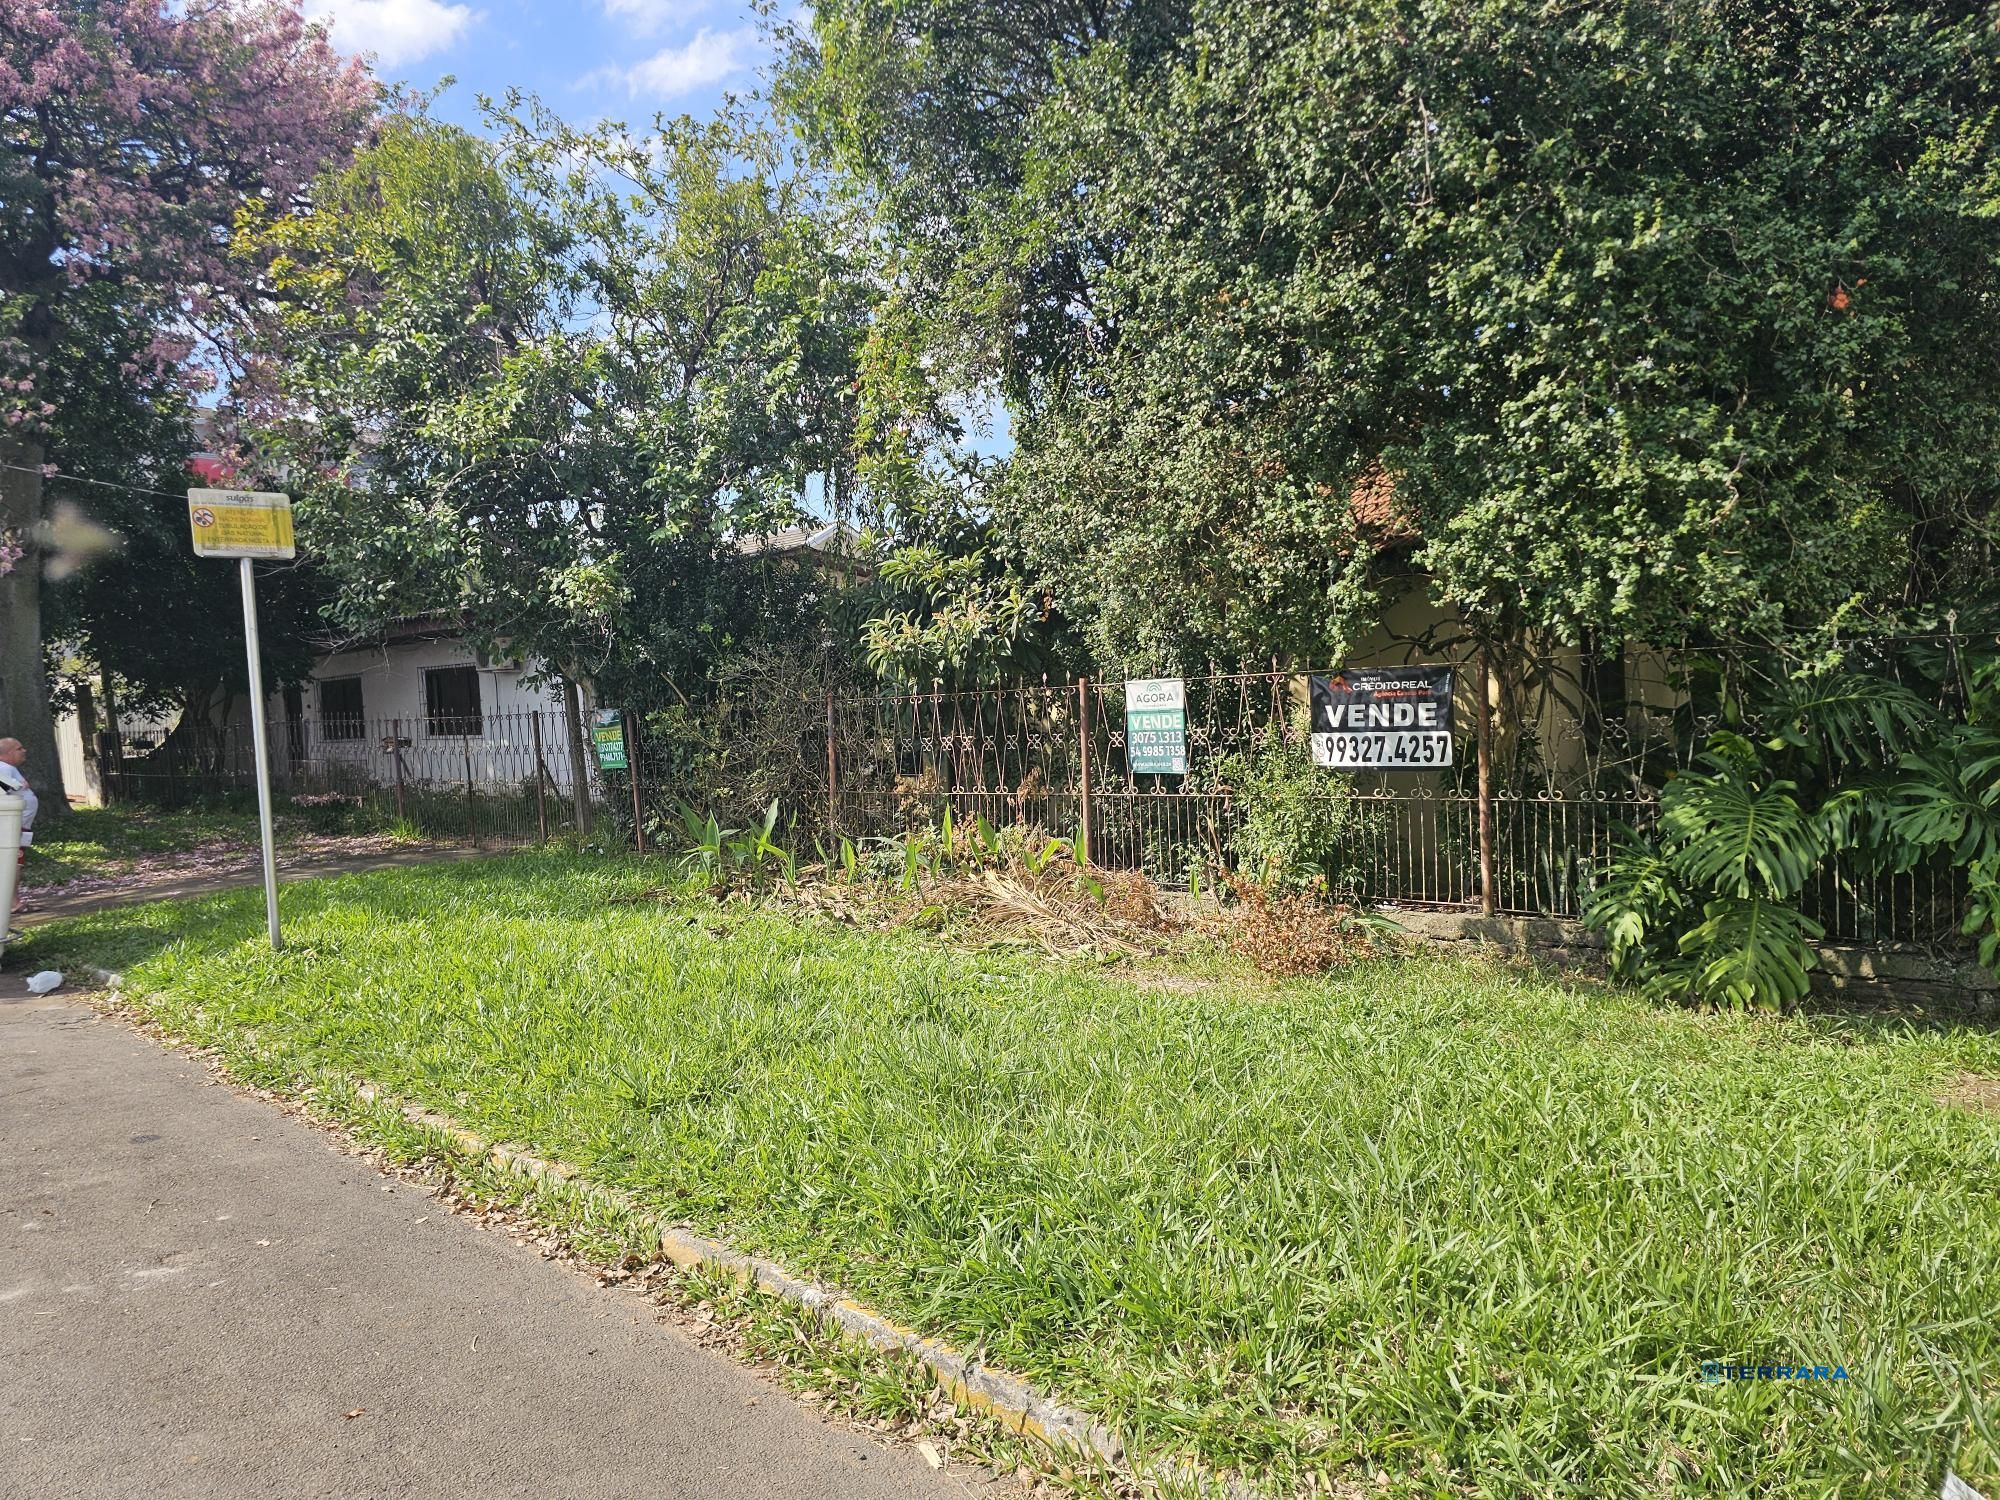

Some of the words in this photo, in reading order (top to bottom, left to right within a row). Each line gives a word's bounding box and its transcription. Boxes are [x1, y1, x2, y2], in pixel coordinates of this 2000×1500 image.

[1352, 681, 1400, 692] CRÉDITO
[1401, 680, 1432, 689] REAL
[1324, 702, 1438, 728] VENDE
[1131, 714, 1182, 730] VENDE
[595, 730, 622, 742] VENDE
[1131, 731, 1156, 744] 3075
[1158, 731, 1182, 743] 1313
[1142, 746, 1164, 757] 9985
[1165, 745, 1186, 757] 7358
[1325, 735, 1448, 763] 99327.4257
